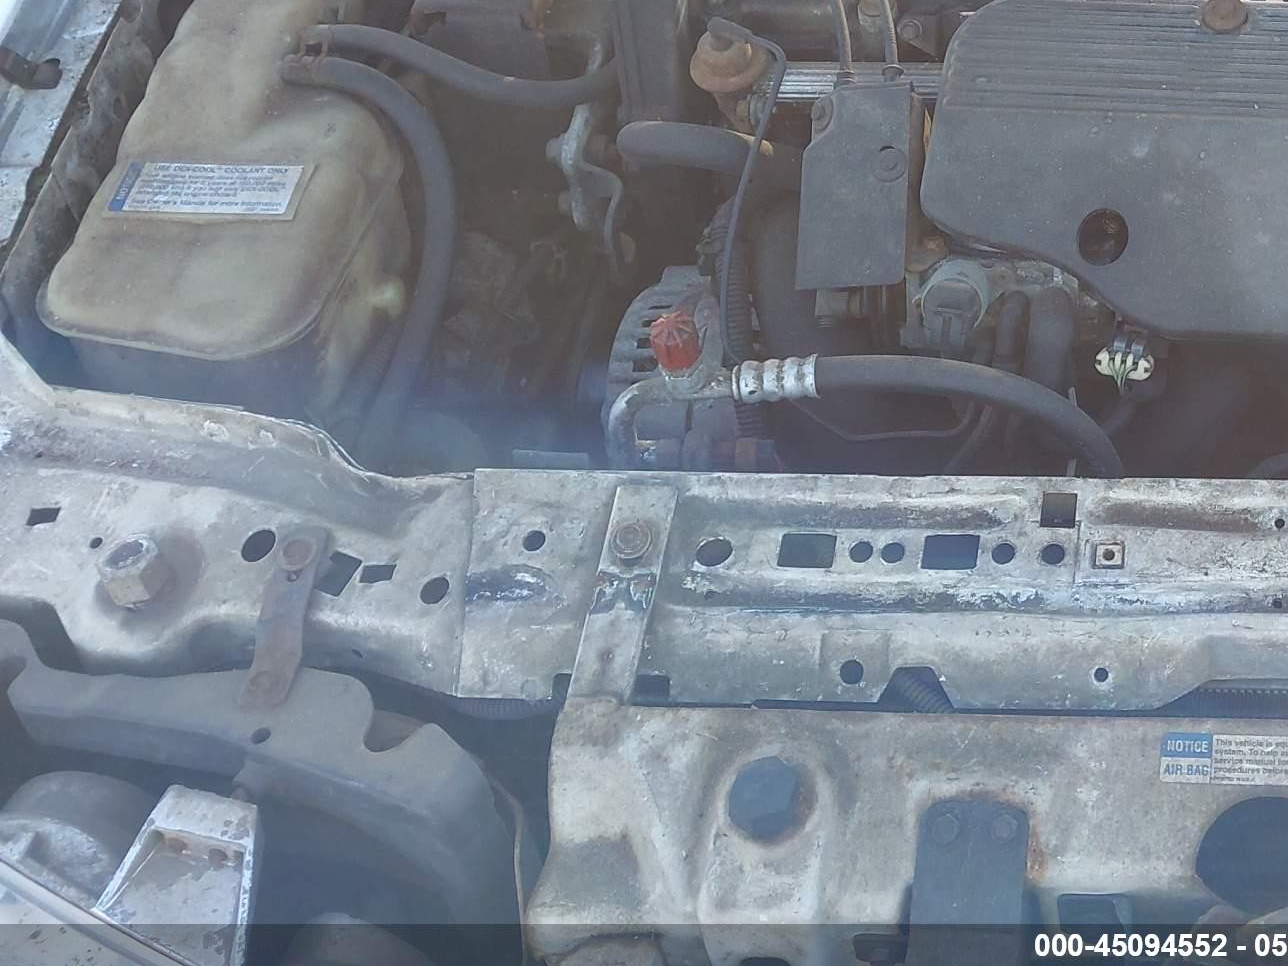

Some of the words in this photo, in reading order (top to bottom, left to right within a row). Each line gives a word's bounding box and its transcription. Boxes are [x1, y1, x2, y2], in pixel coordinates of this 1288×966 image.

[1166, 740, 1208, 753] NOTICE
[1215, 738, 1233, 747] This
[1234, 739, 1264, 748] vehicle
[1214, 749, 1246, 757] system.
[1248, 748, 1259, 756] To
[1260, 749, 1279, 758] help
[1163, 763, 1186, 776] AIR
[1187, 764, 1210, 777] BAG
[1213, 766, 1260, 775] procedures
[1262, 766, 1288, 775] before
